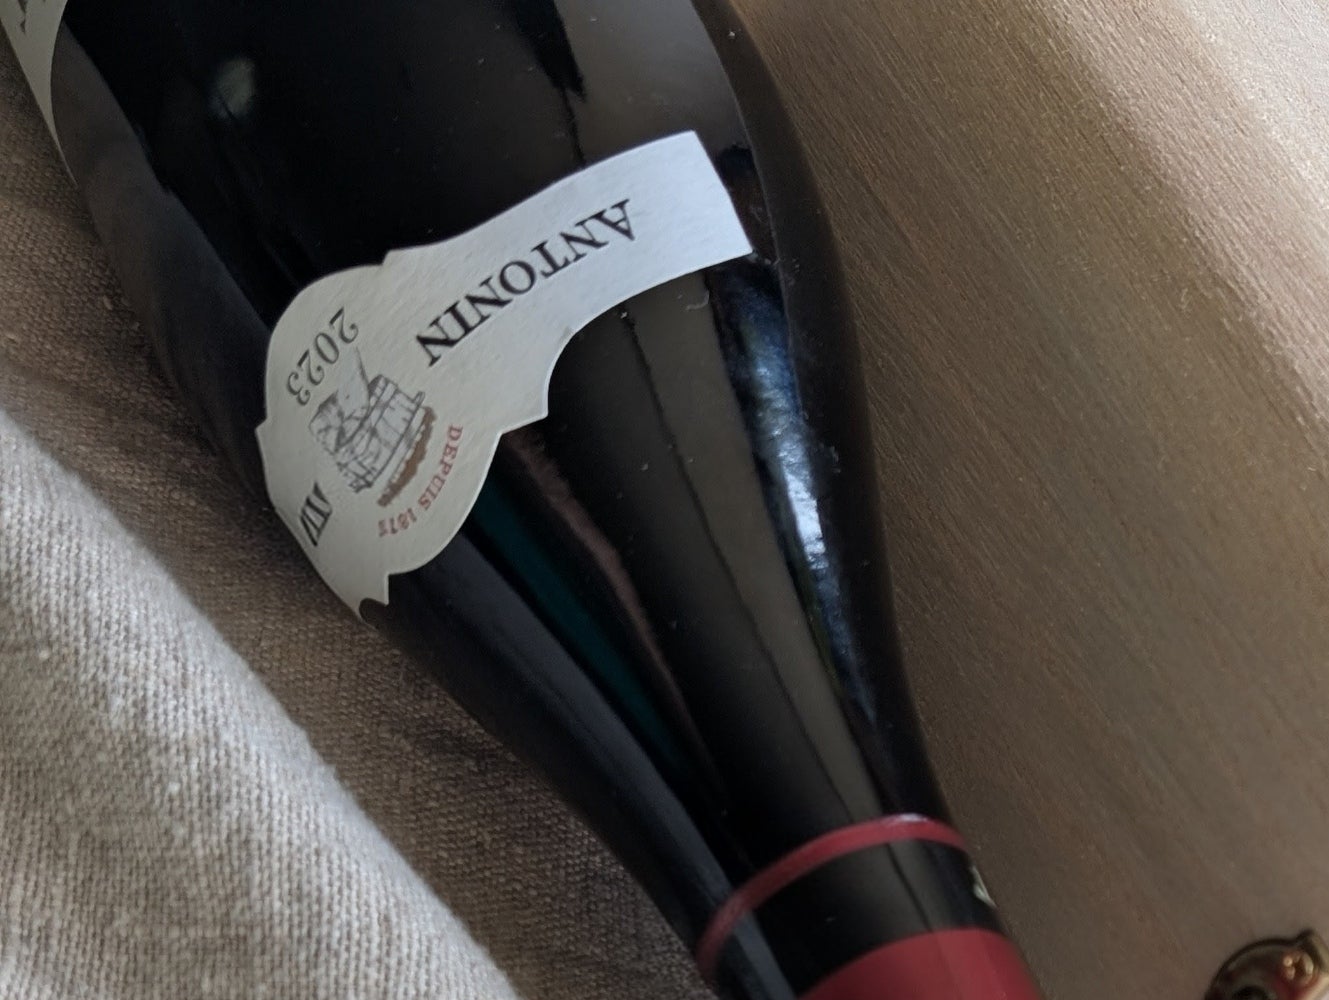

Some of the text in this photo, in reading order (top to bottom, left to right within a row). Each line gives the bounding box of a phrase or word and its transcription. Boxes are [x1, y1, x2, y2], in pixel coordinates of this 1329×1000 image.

[415, 198, 638, 367] ANTONIN
[286, 306, 360, 407] 2023
[419, 424, 464, 513] DEPUIS
